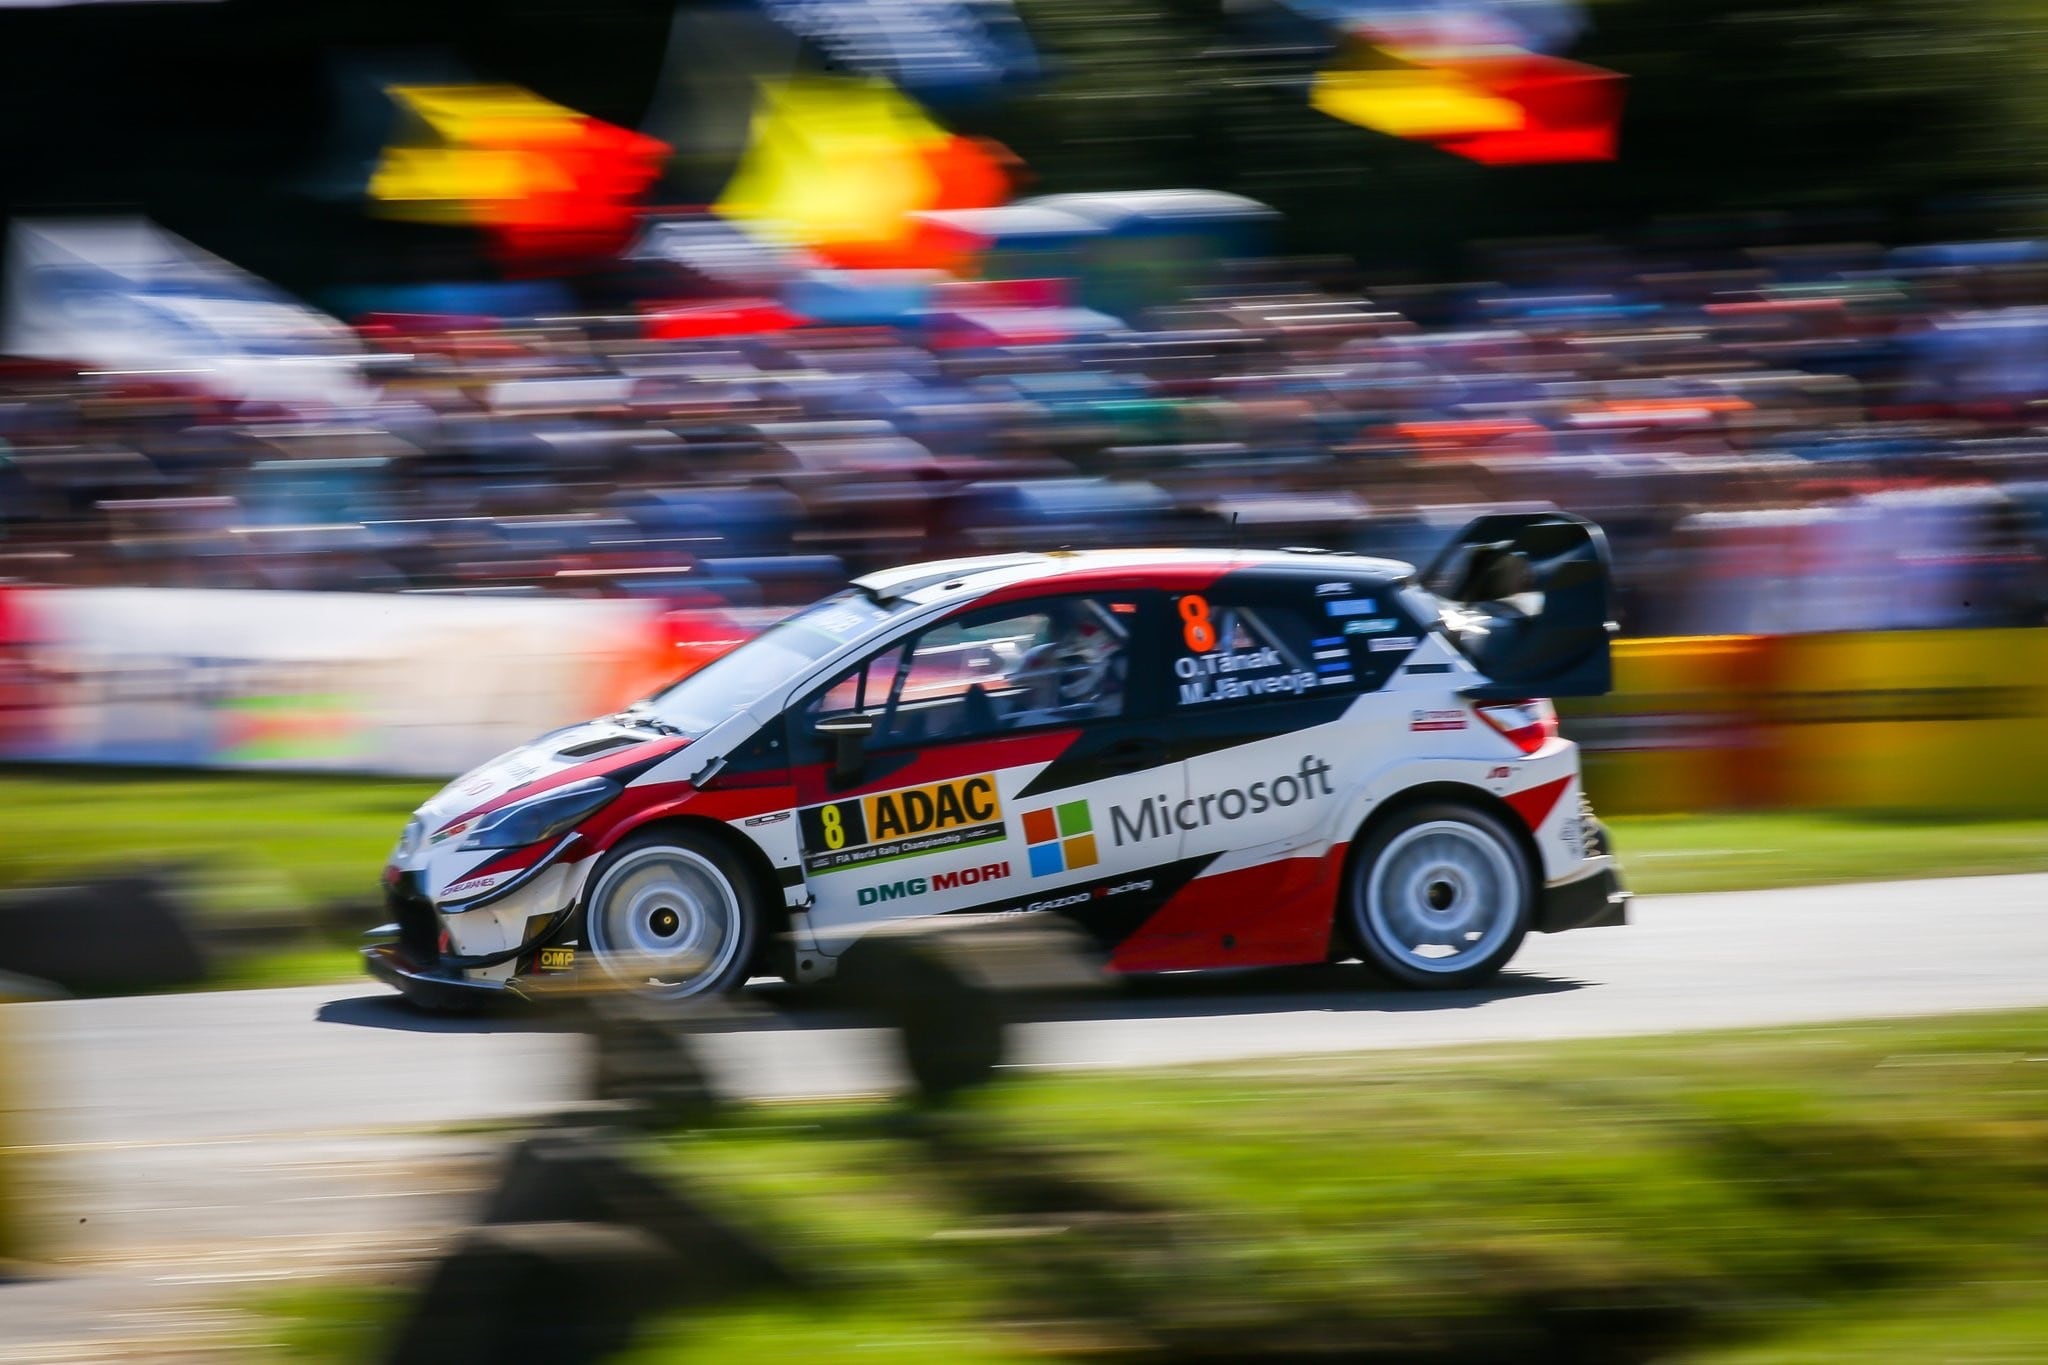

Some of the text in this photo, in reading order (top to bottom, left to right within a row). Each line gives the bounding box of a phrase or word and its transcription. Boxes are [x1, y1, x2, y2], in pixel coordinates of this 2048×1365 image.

[1177, 594, 1217, 652] 8
[821, 777, 994, 850] 8 ADAC
[1109, 754, 1335, 847] Microsoft
[836, 855, 850, 865] FIA
[852, 849, 876, 861] World
[879, 845, 900, 856] Rally
[902, 834, 961, 851] Championship
[857, 861, 1011, 906] DMG MORI
[541, 951, 575, 966] OMP
